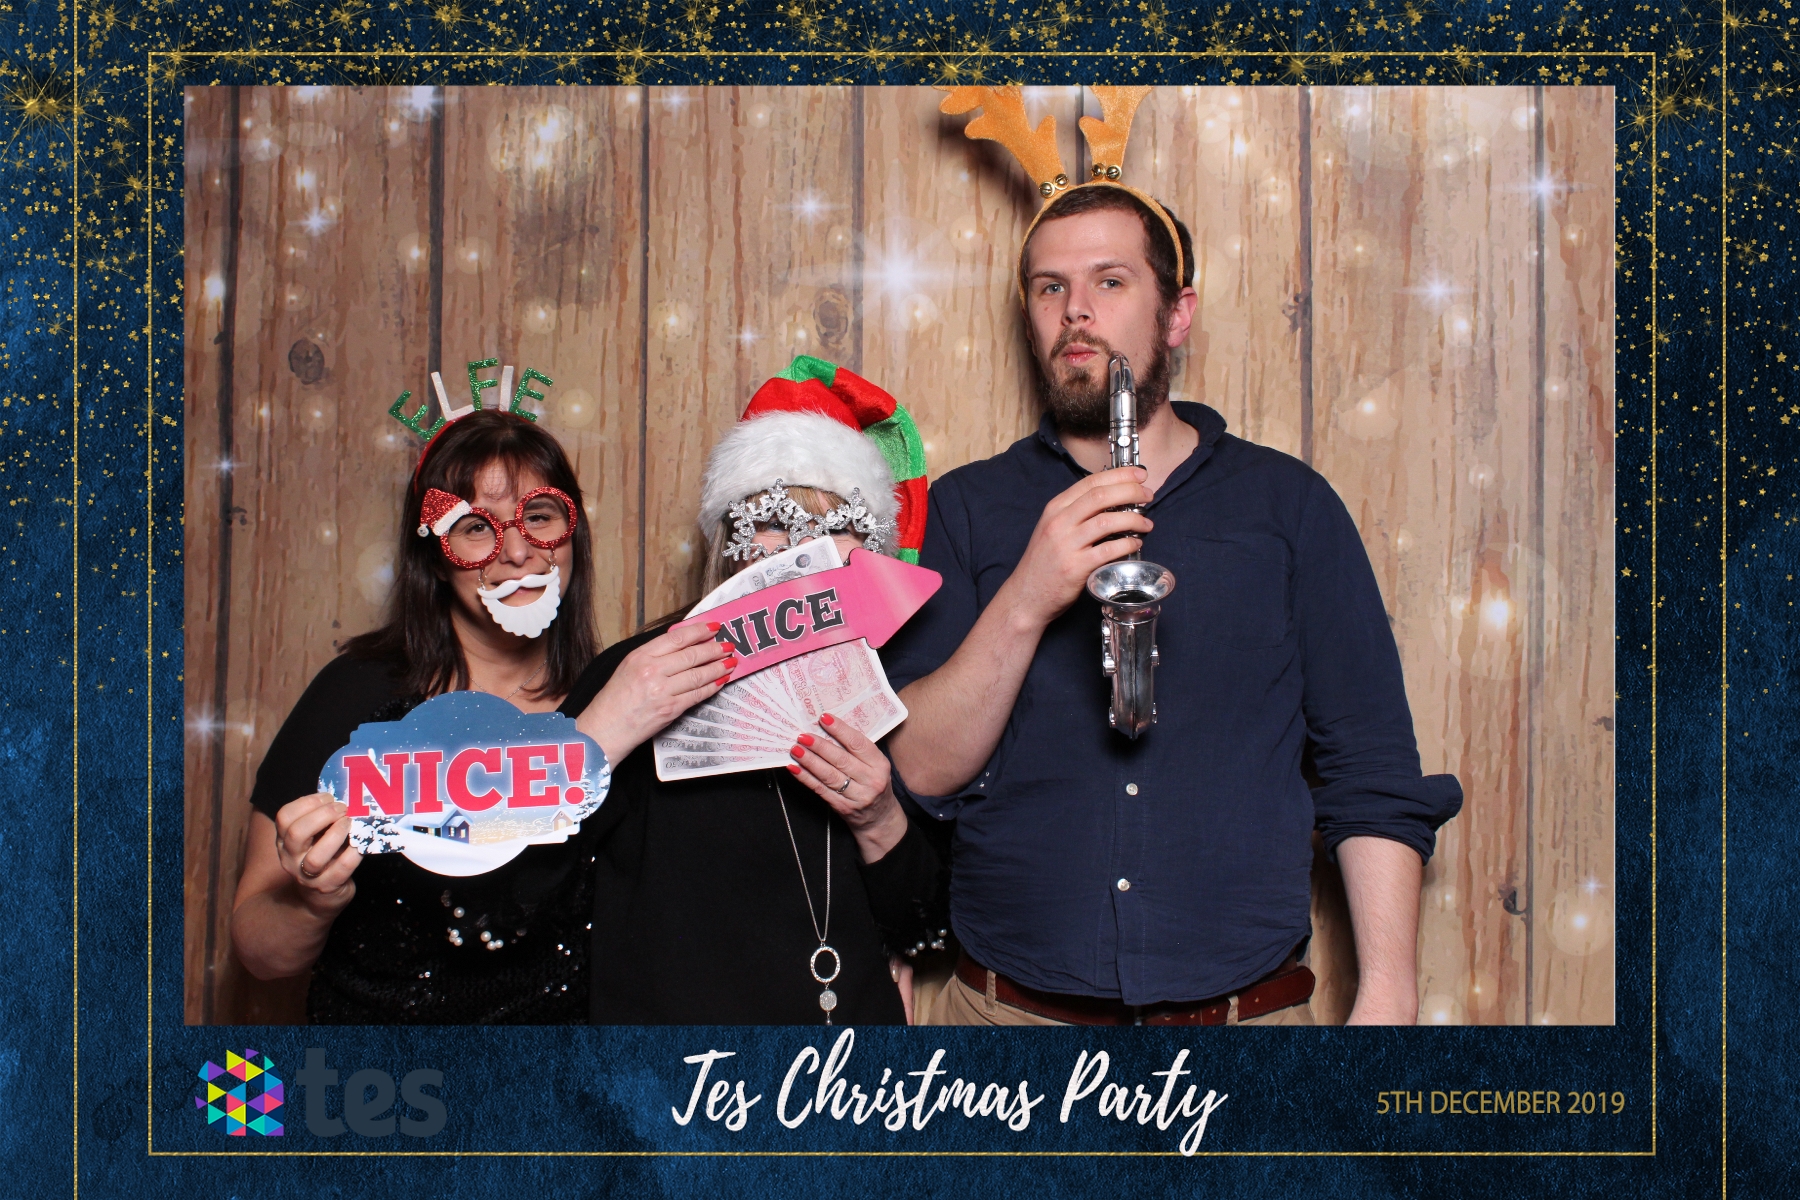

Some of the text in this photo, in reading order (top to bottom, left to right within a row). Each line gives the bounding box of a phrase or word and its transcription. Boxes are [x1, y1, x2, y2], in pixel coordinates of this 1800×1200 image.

[388, 357, 554, 442] ELFIE
[714, 587, 845, 658] NICE
[342, 741, 586, 818] NICE!
